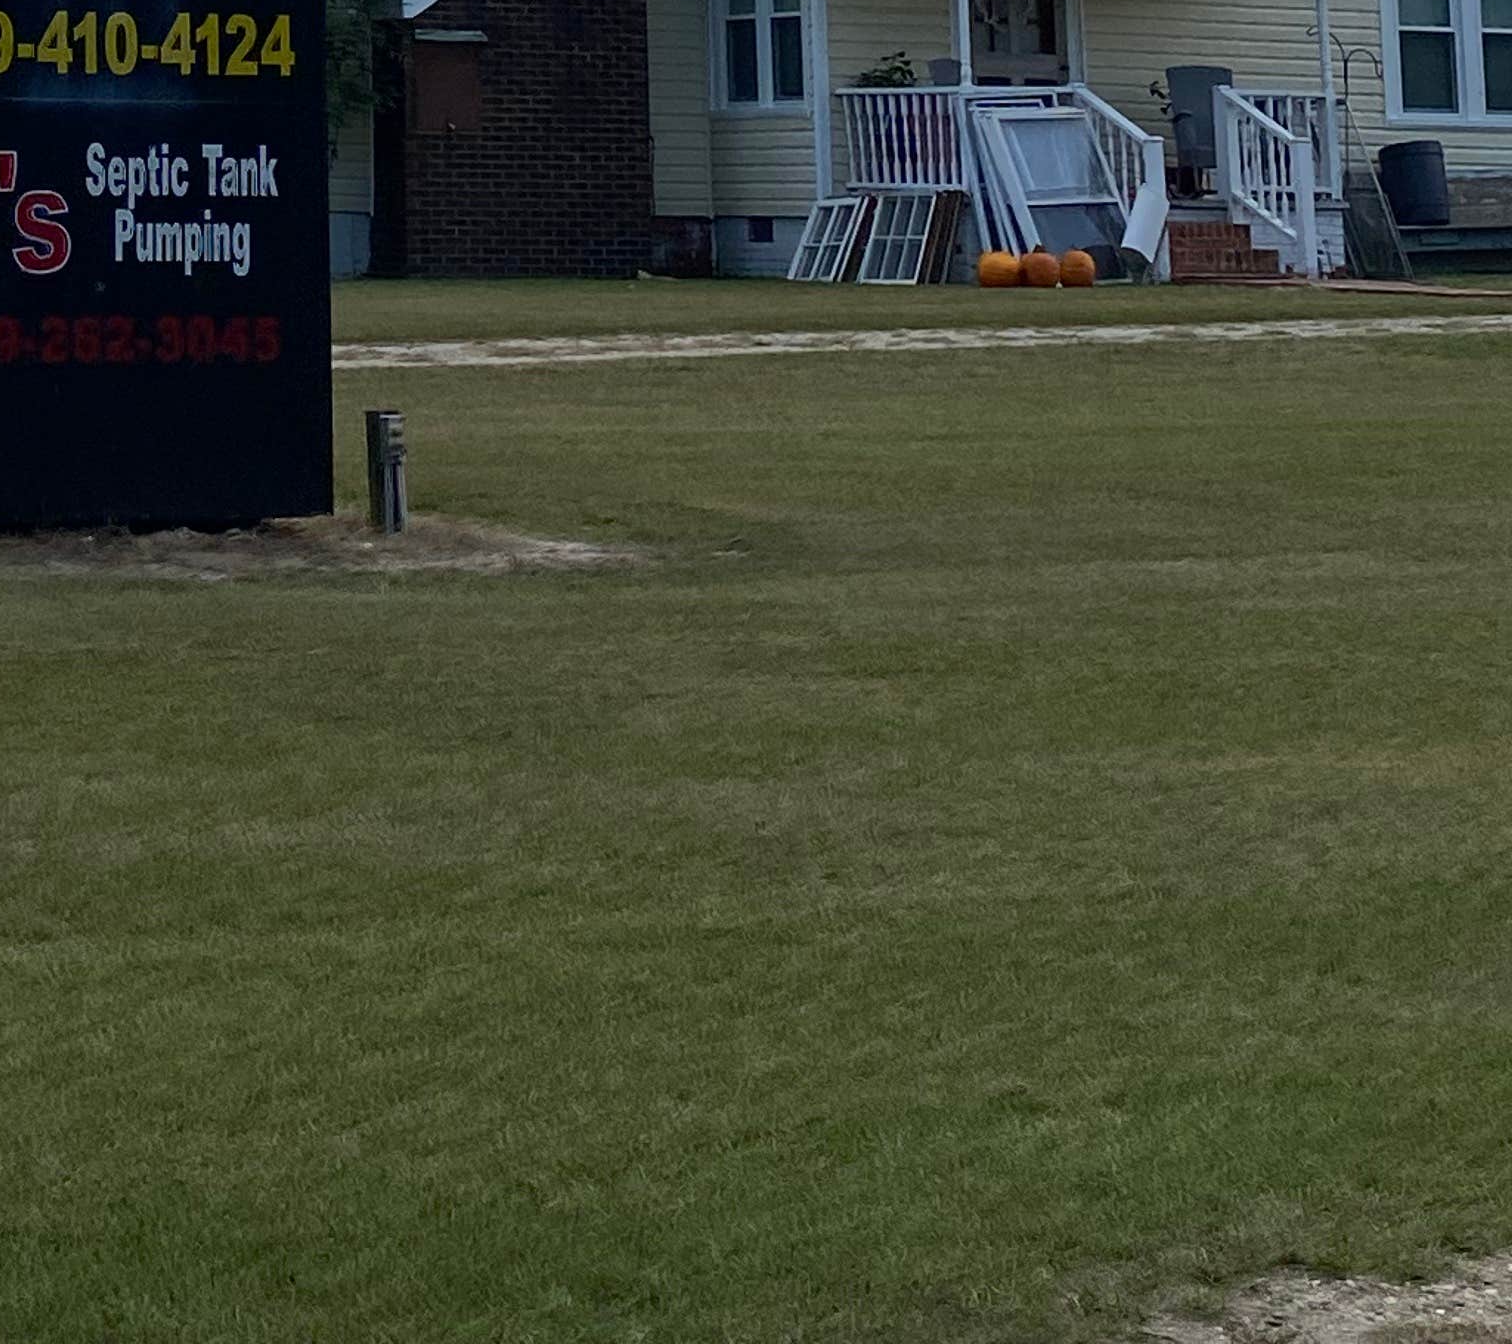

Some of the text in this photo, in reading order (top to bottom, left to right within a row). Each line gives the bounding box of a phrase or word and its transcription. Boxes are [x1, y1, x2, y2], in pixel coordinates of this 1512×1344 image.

[86, 141, 280, 210] Septic Tank
[114, 208, 251, 277] Pumping
